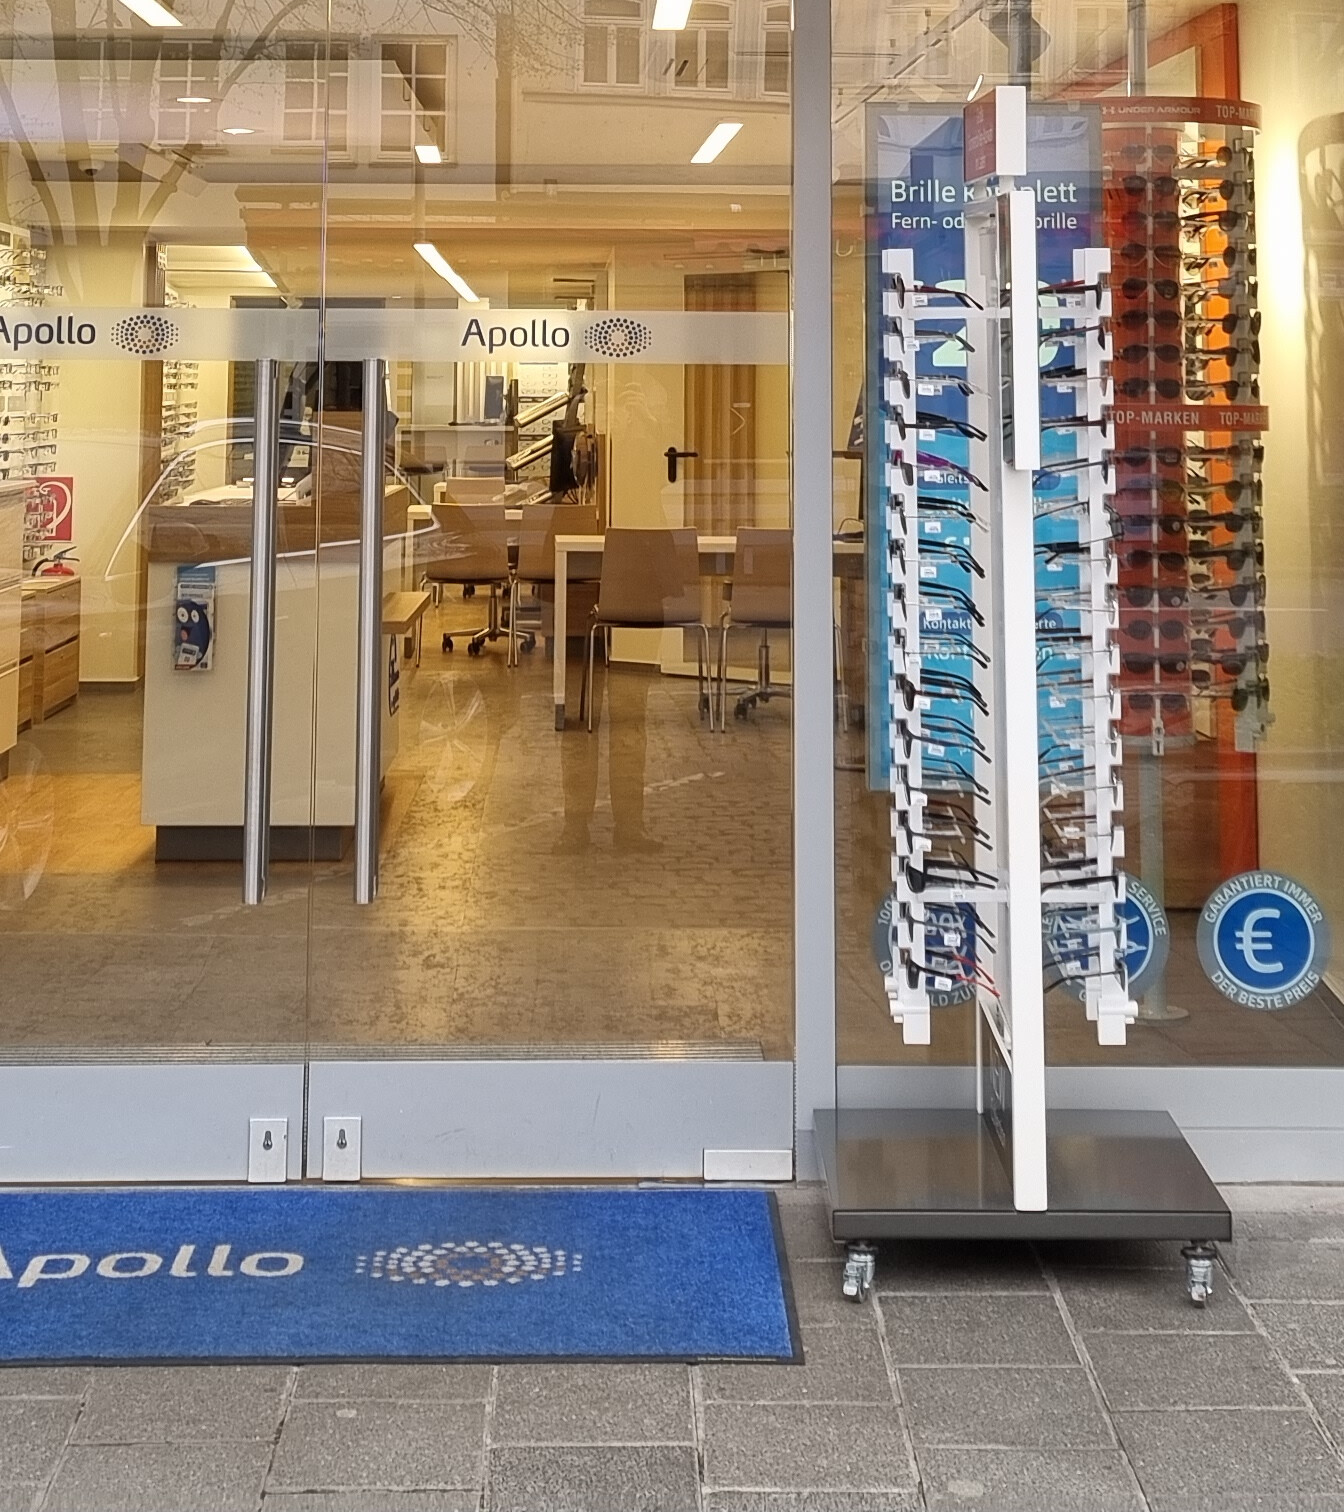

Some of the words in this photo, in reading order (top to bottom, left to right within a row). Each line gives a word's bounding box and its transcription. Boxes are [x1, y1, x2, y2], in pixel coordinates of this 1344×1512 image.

[1118, 106, 1155, 114] UNDER
[1156, 106, 1201, 114] ARMOUR
[891, 179, 956, 203] Brille
[891, 212, 938, 229] Fern-
[942, 212, 965, 229] od
[461, 318, 570, 354] Apollo
[1109, 410, 1200, 425] TOP-MARKEN
[1129, 881, 1167, 937] SERVICE
[1204, 873, 1282, 923] GARANTIERT
[1284, 881, 1323, 924] IMMER
[1211, 970, 1237, 999] DER
[1237, 991, 1284, 1009] BESTE
[1284, 970, 1320, 1005] PREIS
